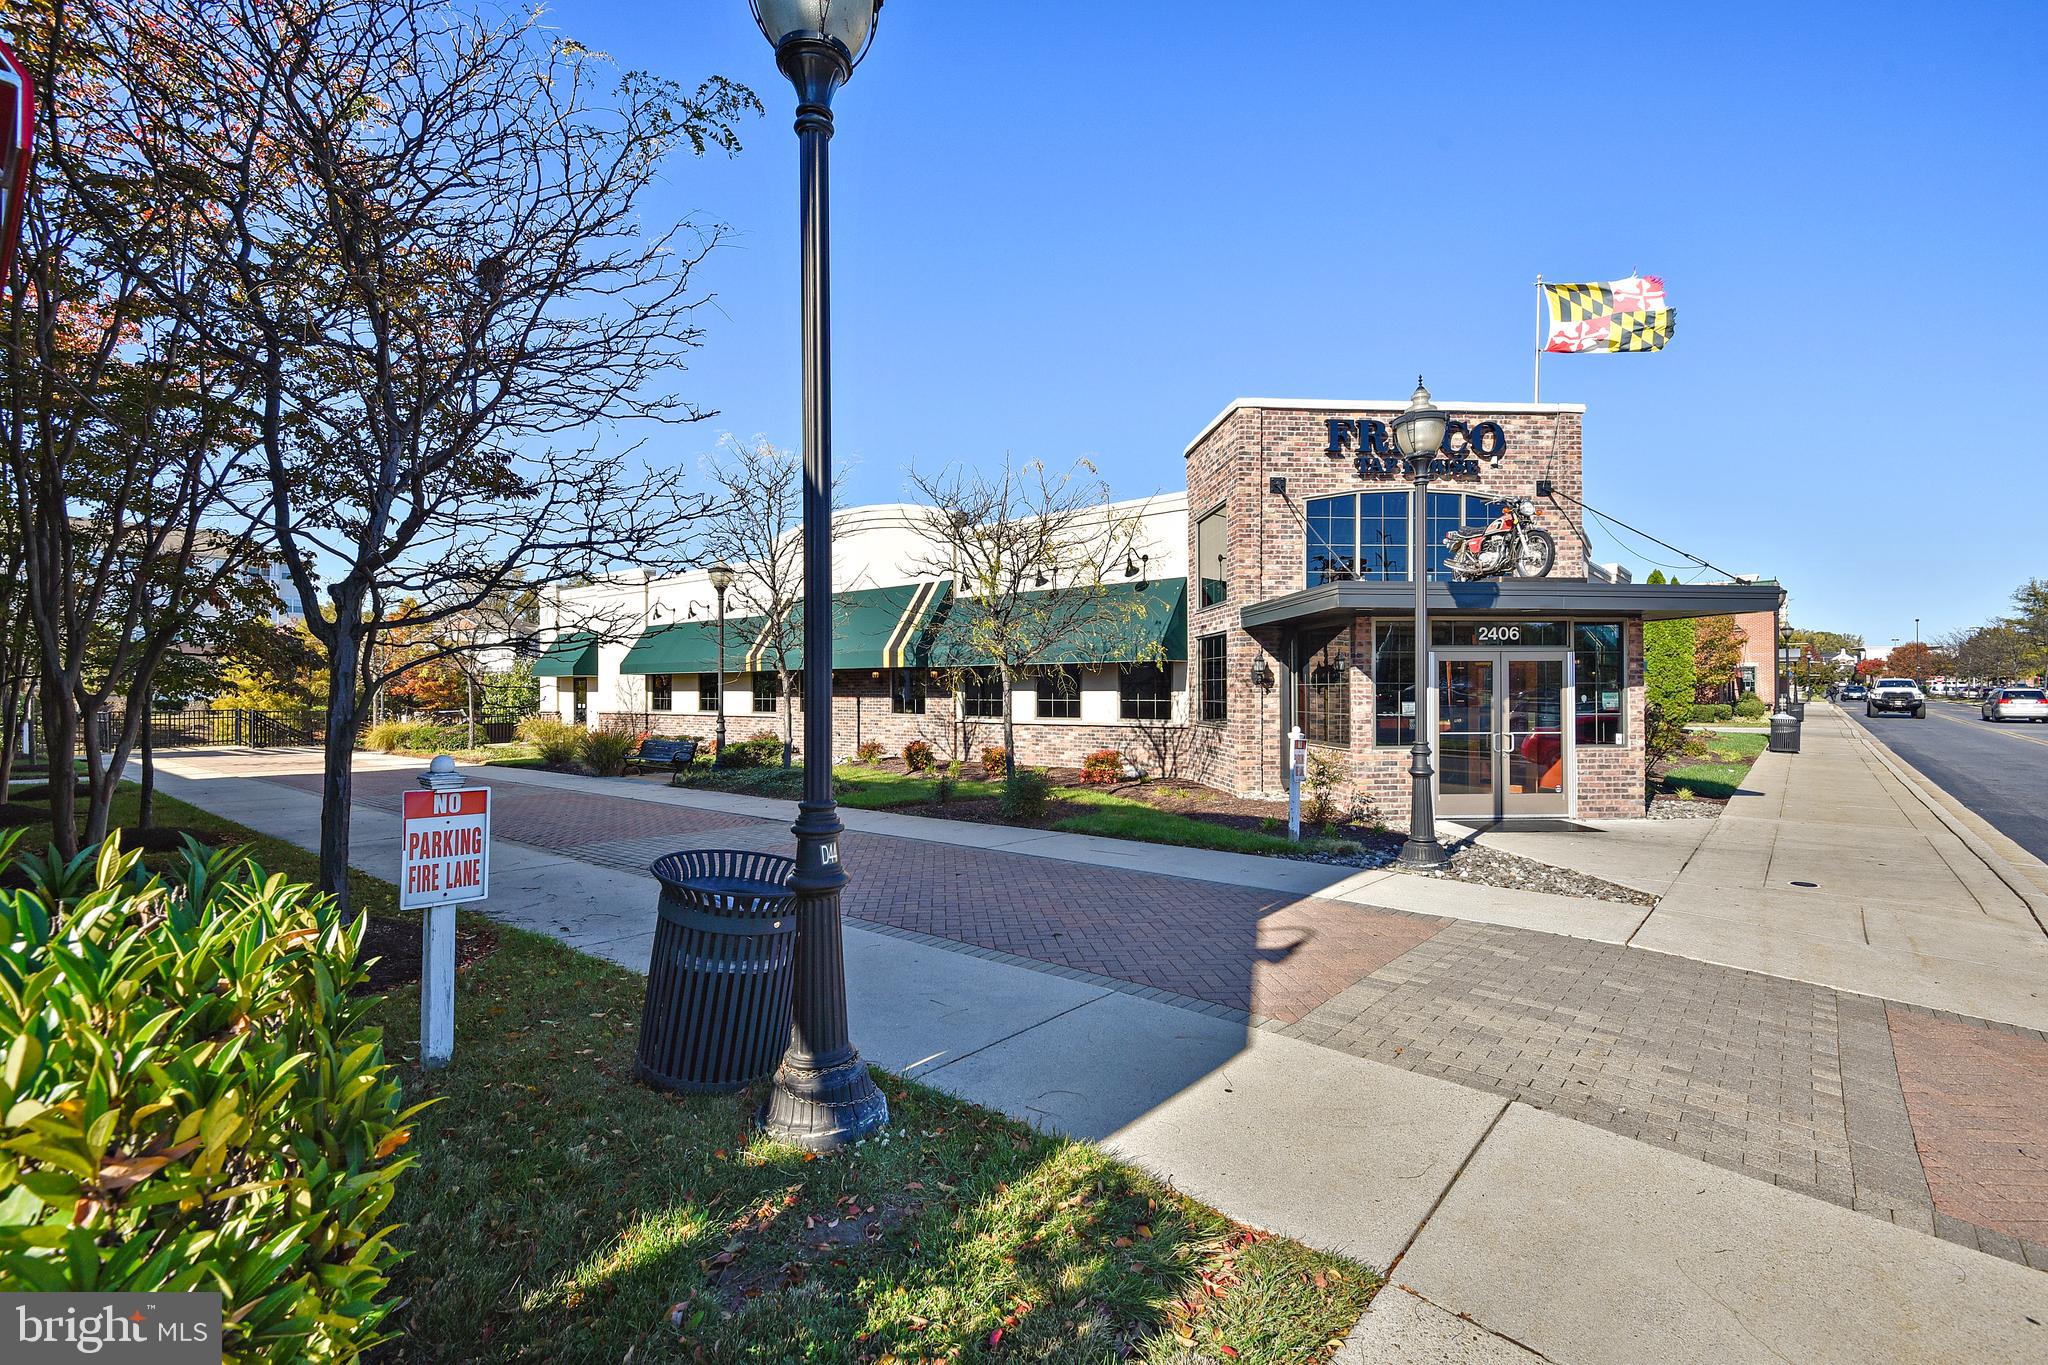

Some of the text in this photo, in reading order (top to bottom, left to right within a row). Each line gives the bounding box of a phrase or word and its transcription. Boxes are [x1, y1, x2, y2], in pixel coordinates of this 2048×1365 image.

[1324, 419, 1506, 459] FRCO
[1479, 627, 1519, 640] 2406
[433, 793, 461, 814] NO
[409, 827, 481, 860] PARKING
[409, 859, 480, 894] FIRE LANE
